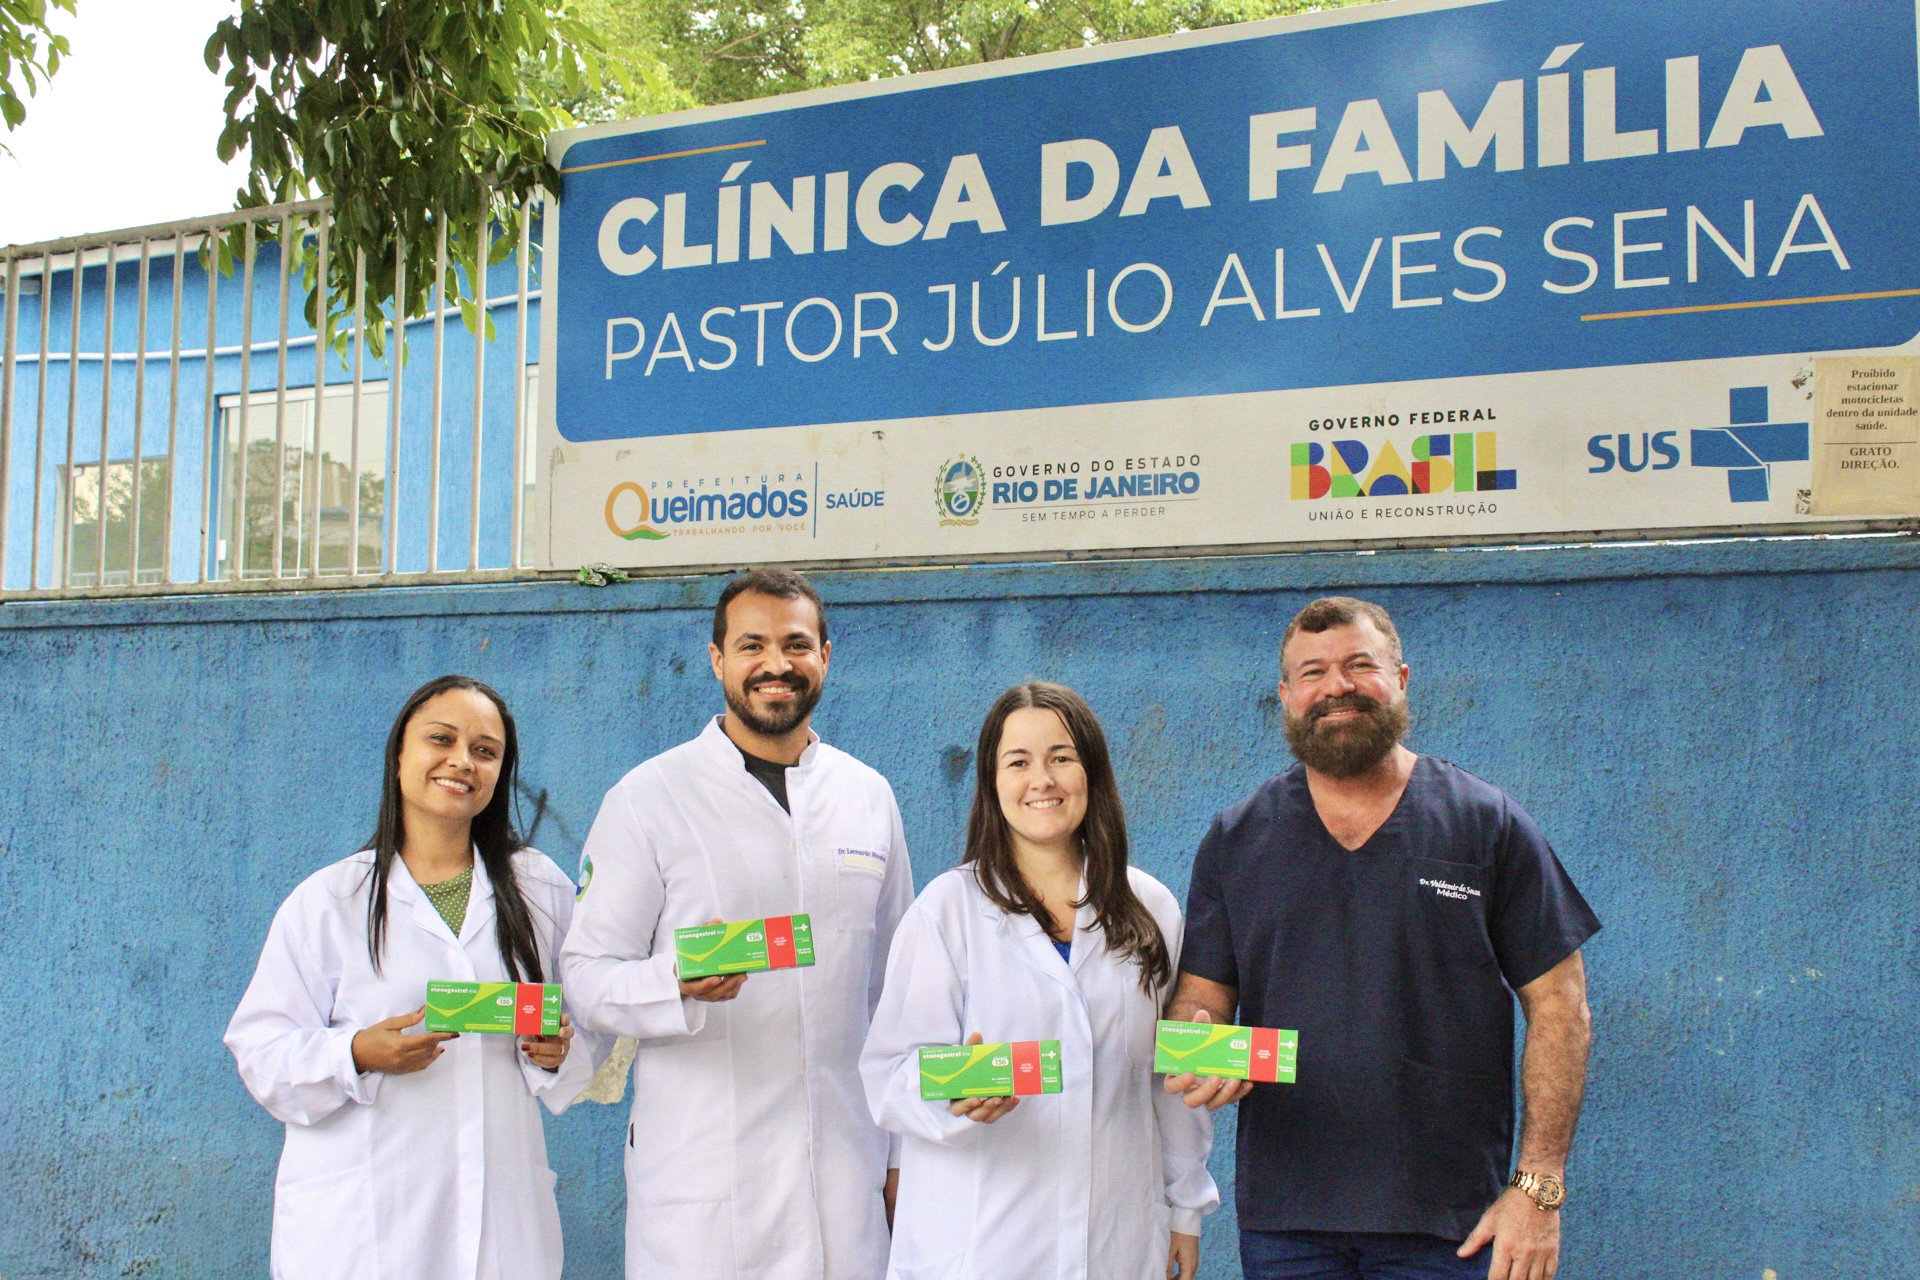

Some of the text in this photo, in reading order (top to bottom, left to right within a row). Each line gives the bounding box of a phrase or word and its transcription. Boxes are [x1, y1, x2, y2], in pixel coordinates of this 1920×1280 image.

[597, 42, 1824, 275] CLÍNICA DA FAMÍLIA
[605, 193, 1851, 380] PASTOR JÚLIO ALVES SENA
[1851, 369, 1896, 378] Proibido
[1847, 382, 1899, 391] estacionar
[1841, 395, 1904, 404] motocicletas
[1309, 408, 1497, 431] GOVERNO FEDERAL
[1826, 407, 1918, 417] dentro da unidade
[1855, 421, 1887, 430] saúde.
[1587, 430, 1680, 473] SUS
[993, 454, 1200, 478] GOVERNO DO ESTADO
[1290, 431, 1517, 500] BRASIL
[1841, 458, 1900, 471] DIREÇÃO.
[651, 473, 803, 490] PREFEITURA
[993, 471, 1200, 504] RIO DE JANEIRO
[826, 488, 885, 509] SAÚDE
[605, 481, 808, 538] Queimados
[1022, 506, 1166, 522] SEM TEMPO A PERDER
[1309, 502, 1497, 521] UNIÃO E RECONSTRUÇÃO
[673, 521, 806, 537] TRABALHANDO POR VOCÊ
[1437, 888, 1468, 900] Médico
[679, 930, 716, 939] etonogestrel
[923, 1052, 962, 1060] etonogestrel
